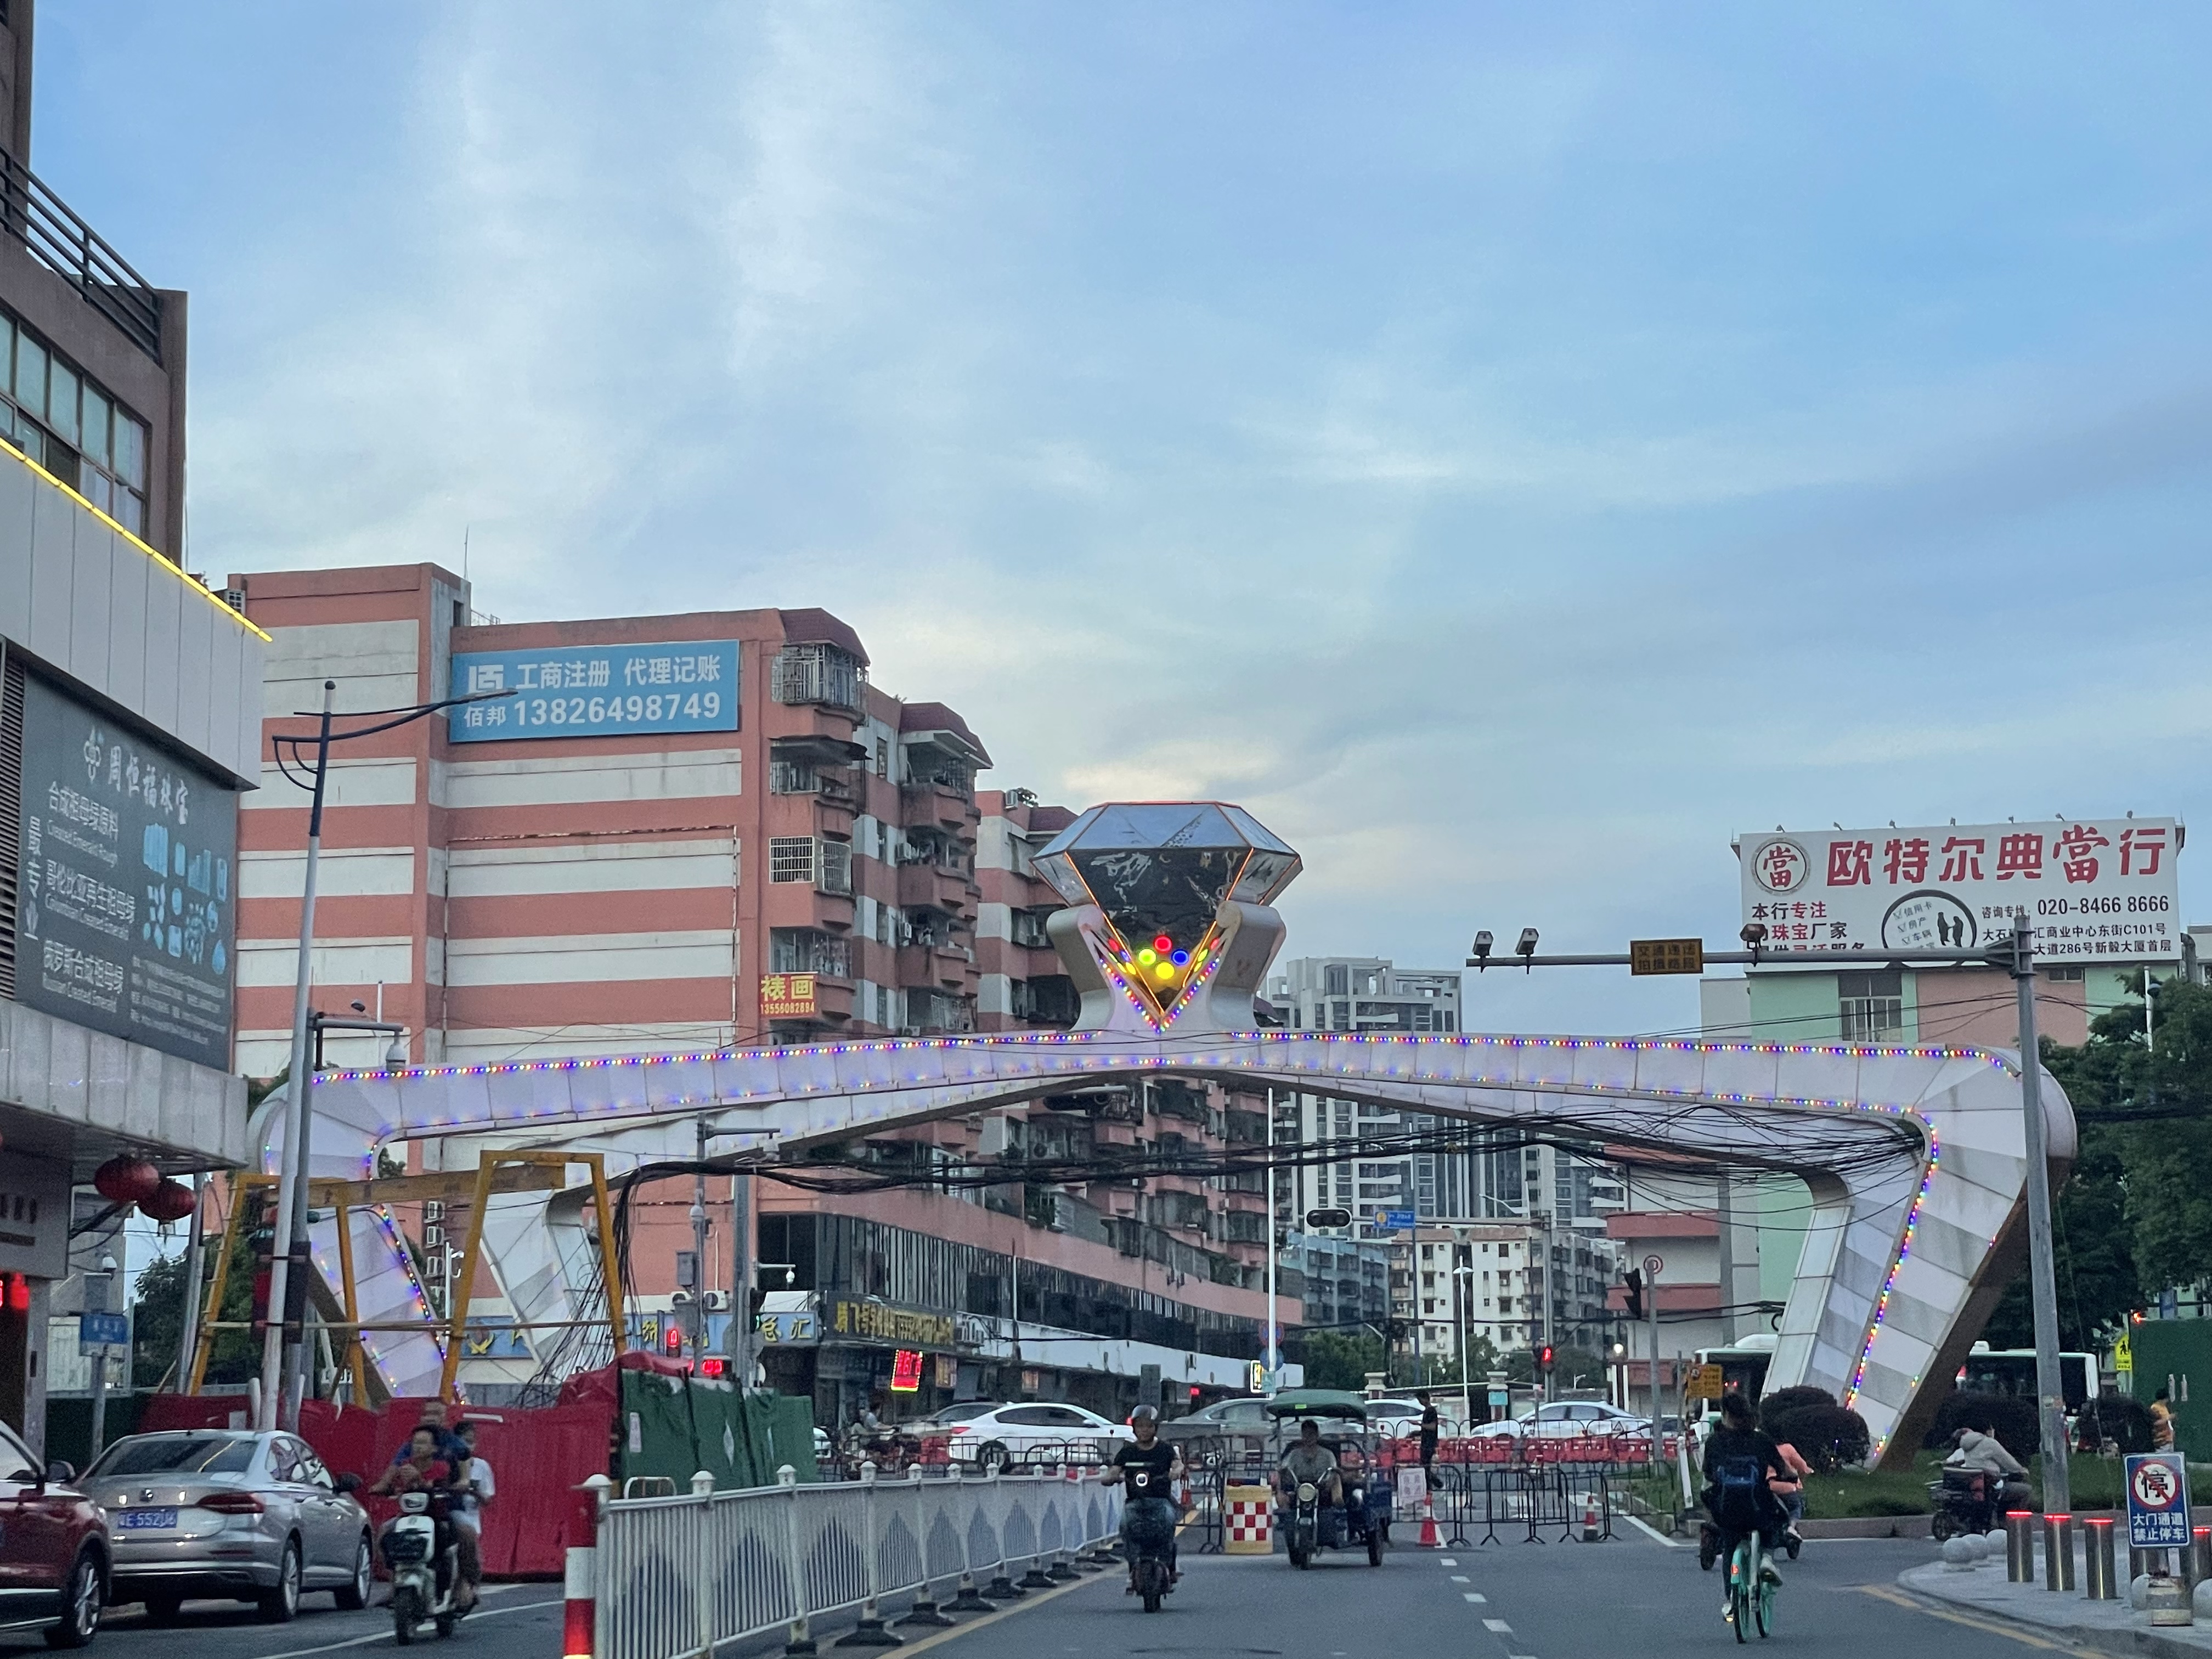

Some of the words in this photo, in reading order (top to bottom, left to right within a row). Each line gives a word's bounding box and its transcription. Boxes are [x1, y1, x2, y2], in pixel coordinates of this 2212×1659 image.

[516, 660, 610, 689] 工商注册
[624, 654, 721, 686] 代理记账
[464, 705, 505, 727] 佰邦
[514, 692, 721, 725] 13826498749
[1826, 823, 2166, 886] 欧特尔典當行
[1763, 845, 1797, 888] 當
[1752, 901, 1827, 920] 本行专注
[2038, 897, 2121, 915] 020-8466
[2128, 895, 2169, 912] 8666
[1760, 922, 1847, 941] 珠宝厂家
[761, 975, 814, 1002] 裱画
[2133, 1512, 2184, 1526] 大门通道
[2134, 1527, 2186, 1542] 禁止停车
